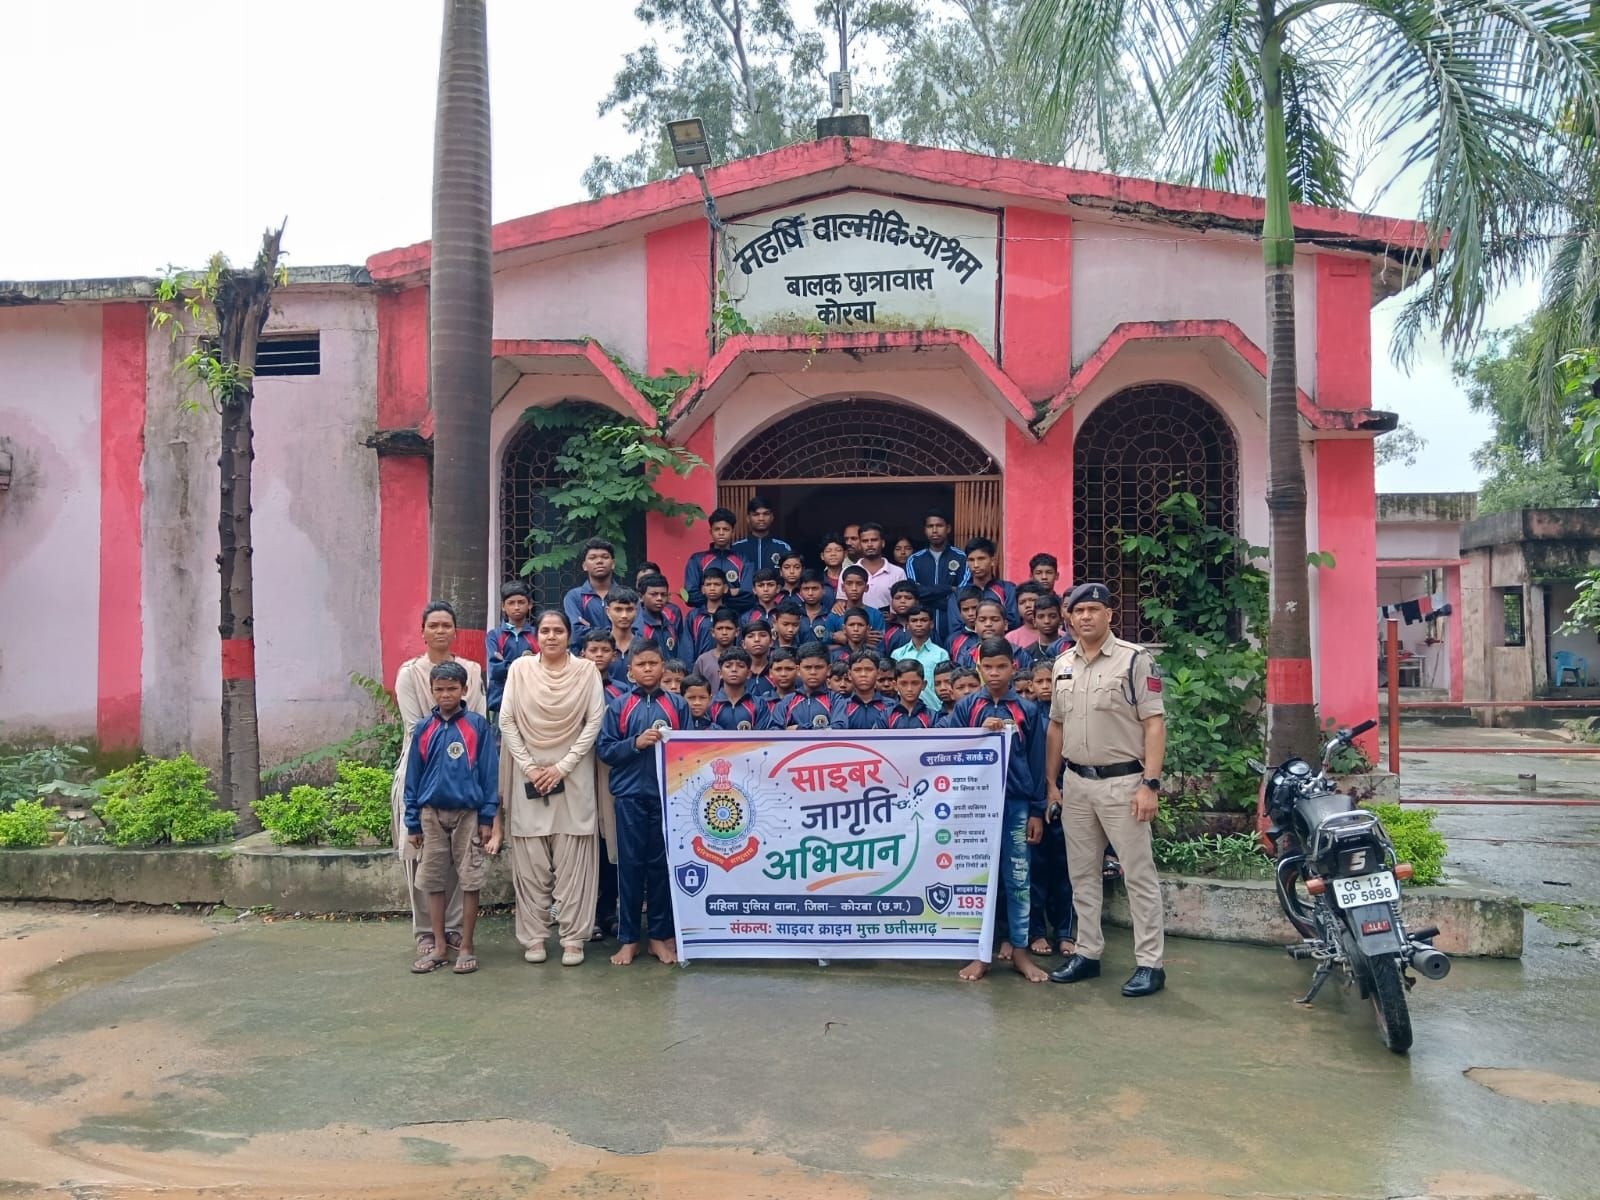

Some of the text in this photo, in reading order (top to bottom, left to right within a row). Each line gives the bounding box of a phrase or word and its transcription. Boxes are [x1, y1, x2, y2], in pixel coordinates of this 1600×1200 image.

[732, 209, 983, 284] महर्षि वाल्मीकि आश्रम
[784, 268, 934, 296] बालक छात्रावास
[816, 298, 876, 325] कोरबा
[788, 759, 884, 792] साइबर
[801, 787, 898, 836] जागृति
[762, 834, 906, 881] अभियान
[1341, 887, 1392, 905] BP 5898
[1344, 877, 1382, 892] CG 12
[709, 899, 738, 912] महिला
[742, 899, 770, 914] पुलिस
[774, 902, 800, 912] थाना,
[840, 899, 872, 911] कोरबा
[877, 900, 911, 913] (छ.ग.)
[729, 920, 937, 938] संकल्प: साइबर क्राइम मुक्त छत्तीसगढ़
